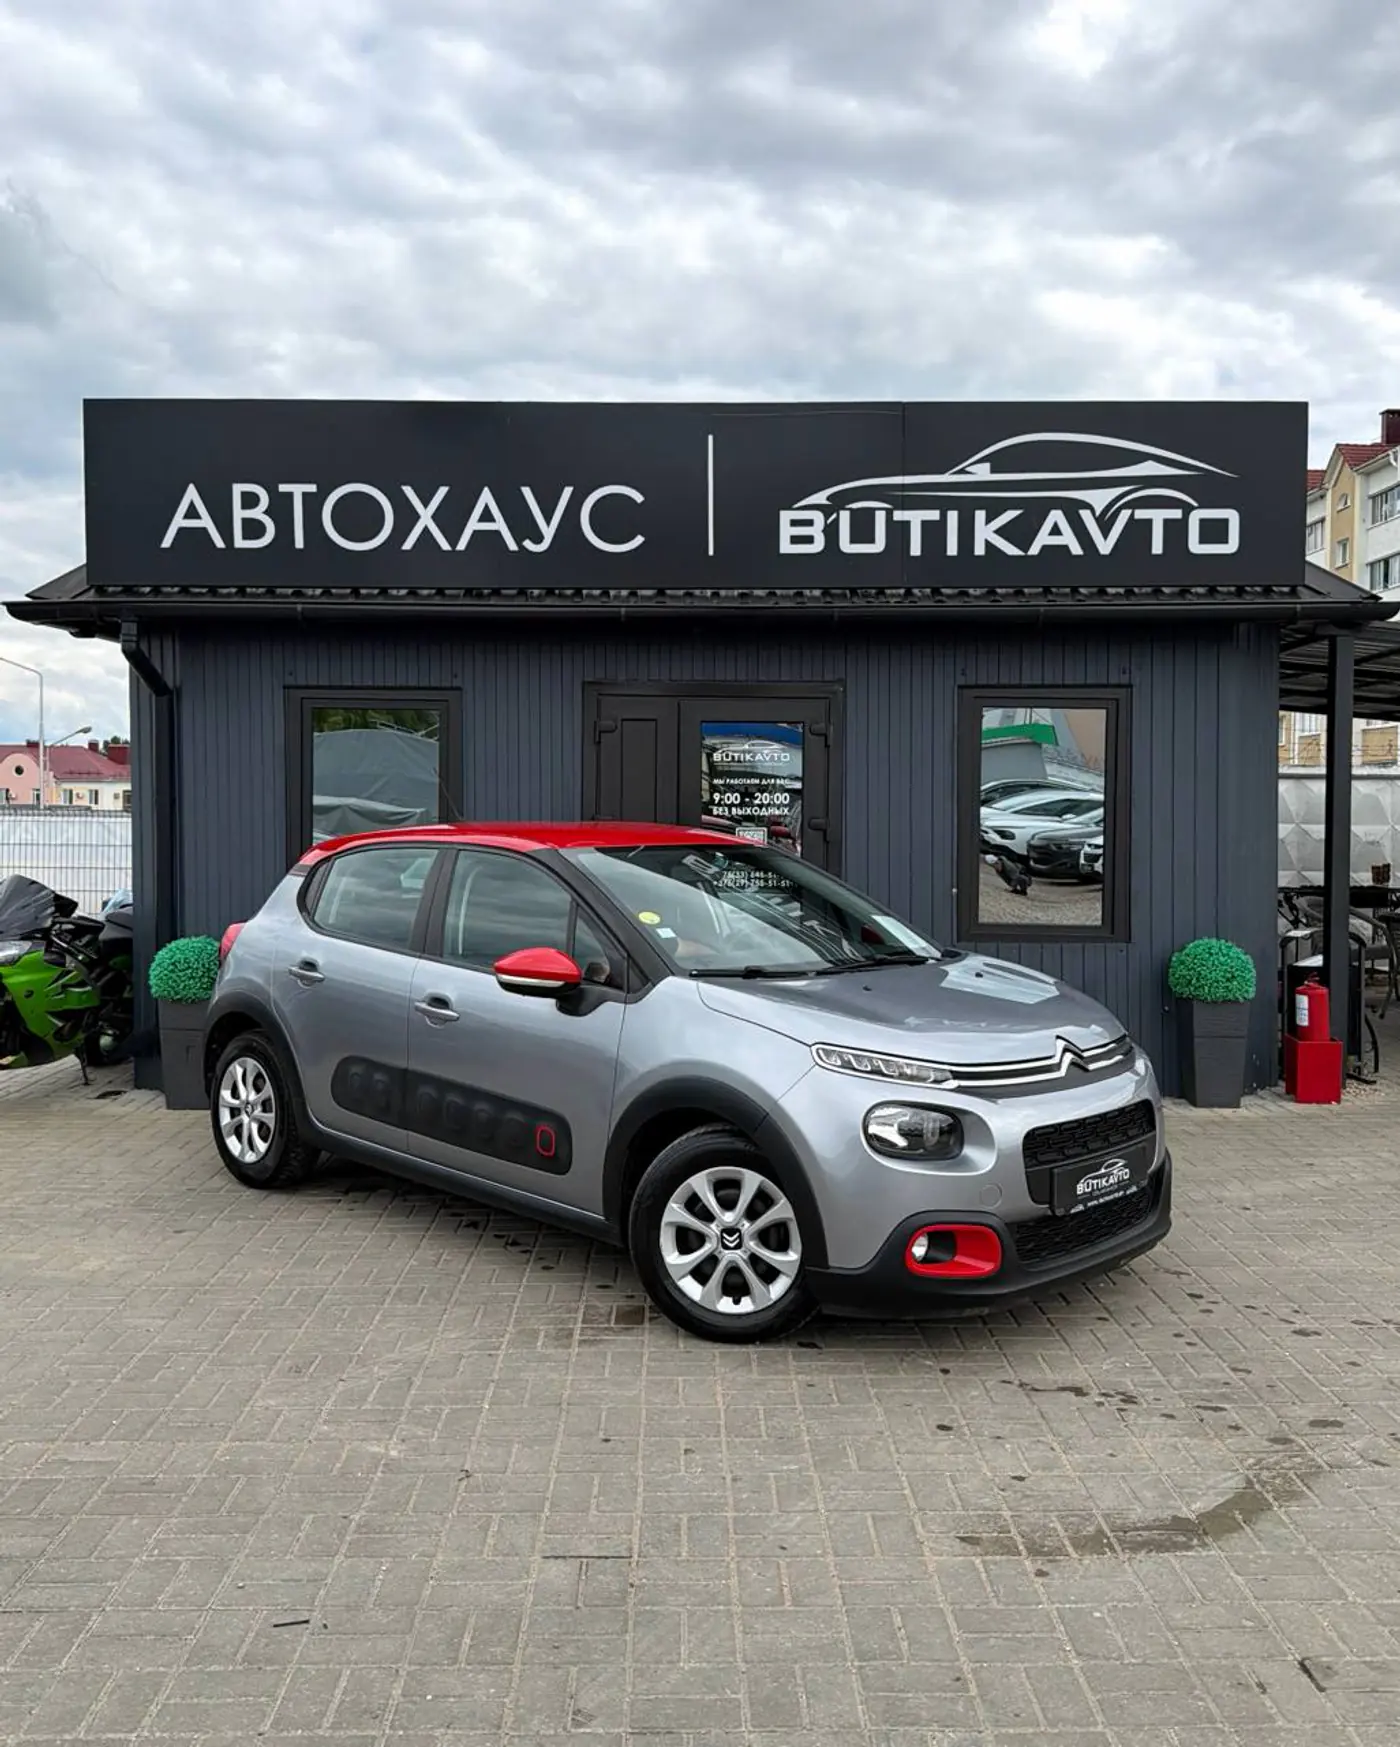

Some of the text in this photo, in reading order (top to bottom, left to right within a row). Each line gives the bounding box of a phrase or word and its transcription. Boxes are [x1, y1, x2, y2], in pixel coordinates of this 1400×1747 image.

[160, 482, 646, 553] АВТОХАУС
[779, 508, 1240, 556] BUTIKAVTO
[713, 752, 790, 761] BUTIKAVTO
[713, 792, 741, 804] 9:00
[753, 792, 790, 804] 20:00
[712, 806, 790, 816] БЕЗ ВЫХОДНЫХ
[1076, 1168, 1130, 1194] BUTIKAVTO
